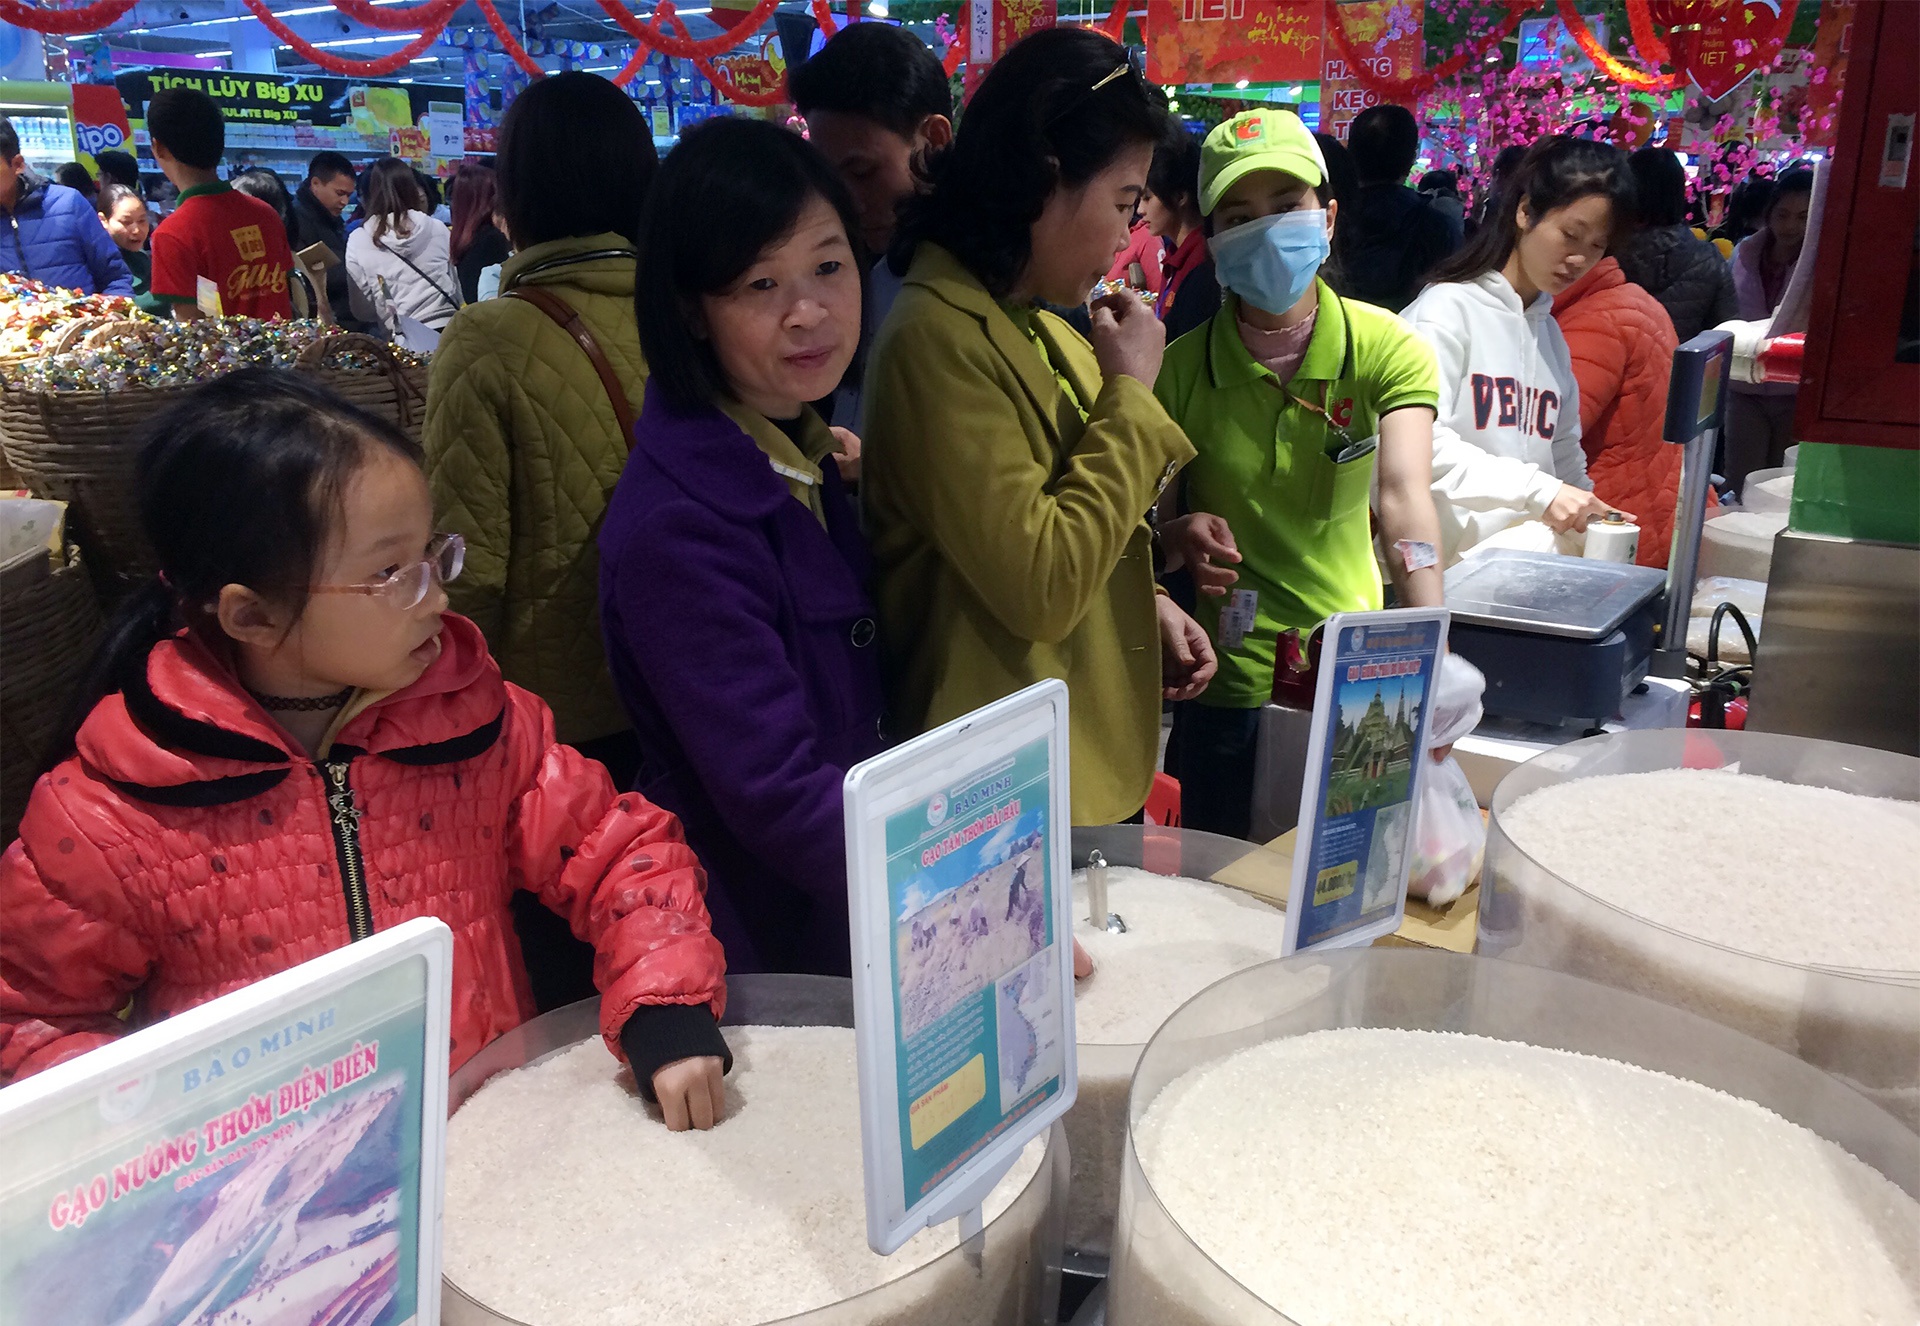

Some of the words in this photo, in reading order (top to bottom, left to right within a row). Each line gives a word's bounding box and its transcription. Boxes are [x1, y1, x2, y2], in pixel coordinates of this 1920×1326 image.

[1031, 15, 1054, 27] 2017
[207, 76, 250, 98] LŨY
[256, 81, 291, 103] Big
[295, 84, 324, 102] XU
[263, 108, 282, 121] Big
[283, 109, 299, 120] XU
[443, 134, 451, 145] 9
[1334, 116, 1358, 140] T
[981, 774, 1013, 800] MINH
[259, 1008, 336, 1058] MINH
[50, 1173, 107, 1230] GẠO
[112, 1128, 198, 1201] NƯƠNG
[202, 1092, 274, 1154] THƠM
[277, 1065, 329, 1118] ĐIỆN
[331, 1040, 380, 1092] BIÊN
